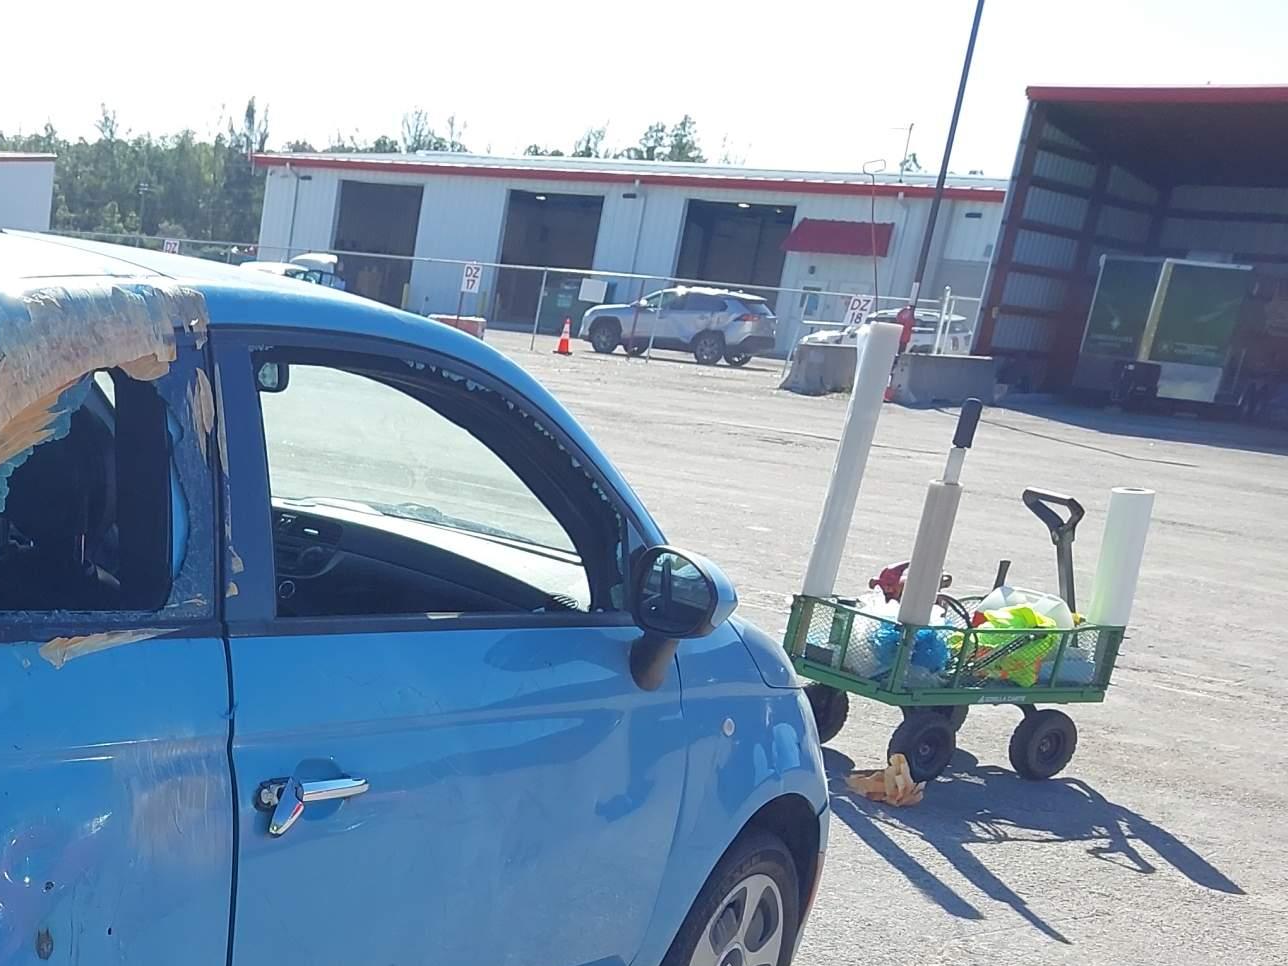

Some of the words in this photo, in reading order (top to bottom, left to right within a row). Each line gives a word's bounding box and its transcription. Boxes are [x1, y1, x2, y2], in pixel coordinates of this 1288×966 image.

[465, 266, 481, 279] DZ
[466, 279, 476, 290] 17
[850, 298, 871, 311] DZ
[849, 312, 863, 324] 18
